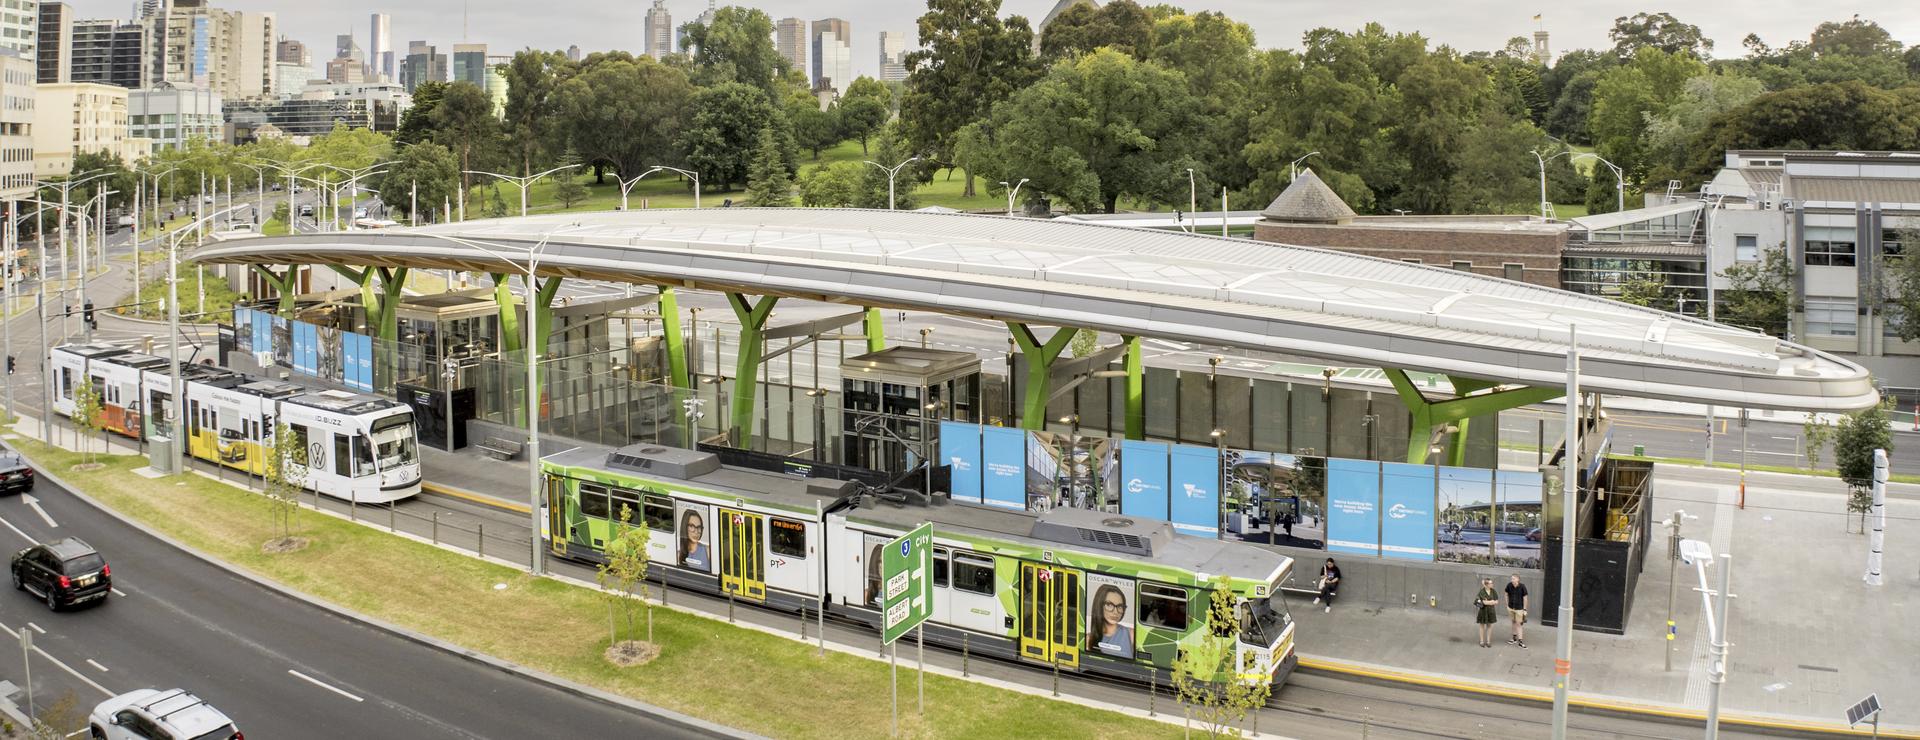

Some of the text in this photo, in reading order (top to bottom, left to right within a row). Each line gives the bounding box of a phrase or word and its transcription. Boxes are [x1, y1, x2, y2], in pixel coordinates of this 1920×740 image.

[903, 542, 909, 551] 3
[915, 534, 930, 547] City
[891, 574, 905, 586] PARK
[889, 582, 908, 598] STREET
[888, 600, 909, 616] ALBERT
[891, 612, 906, 624] ROAD
